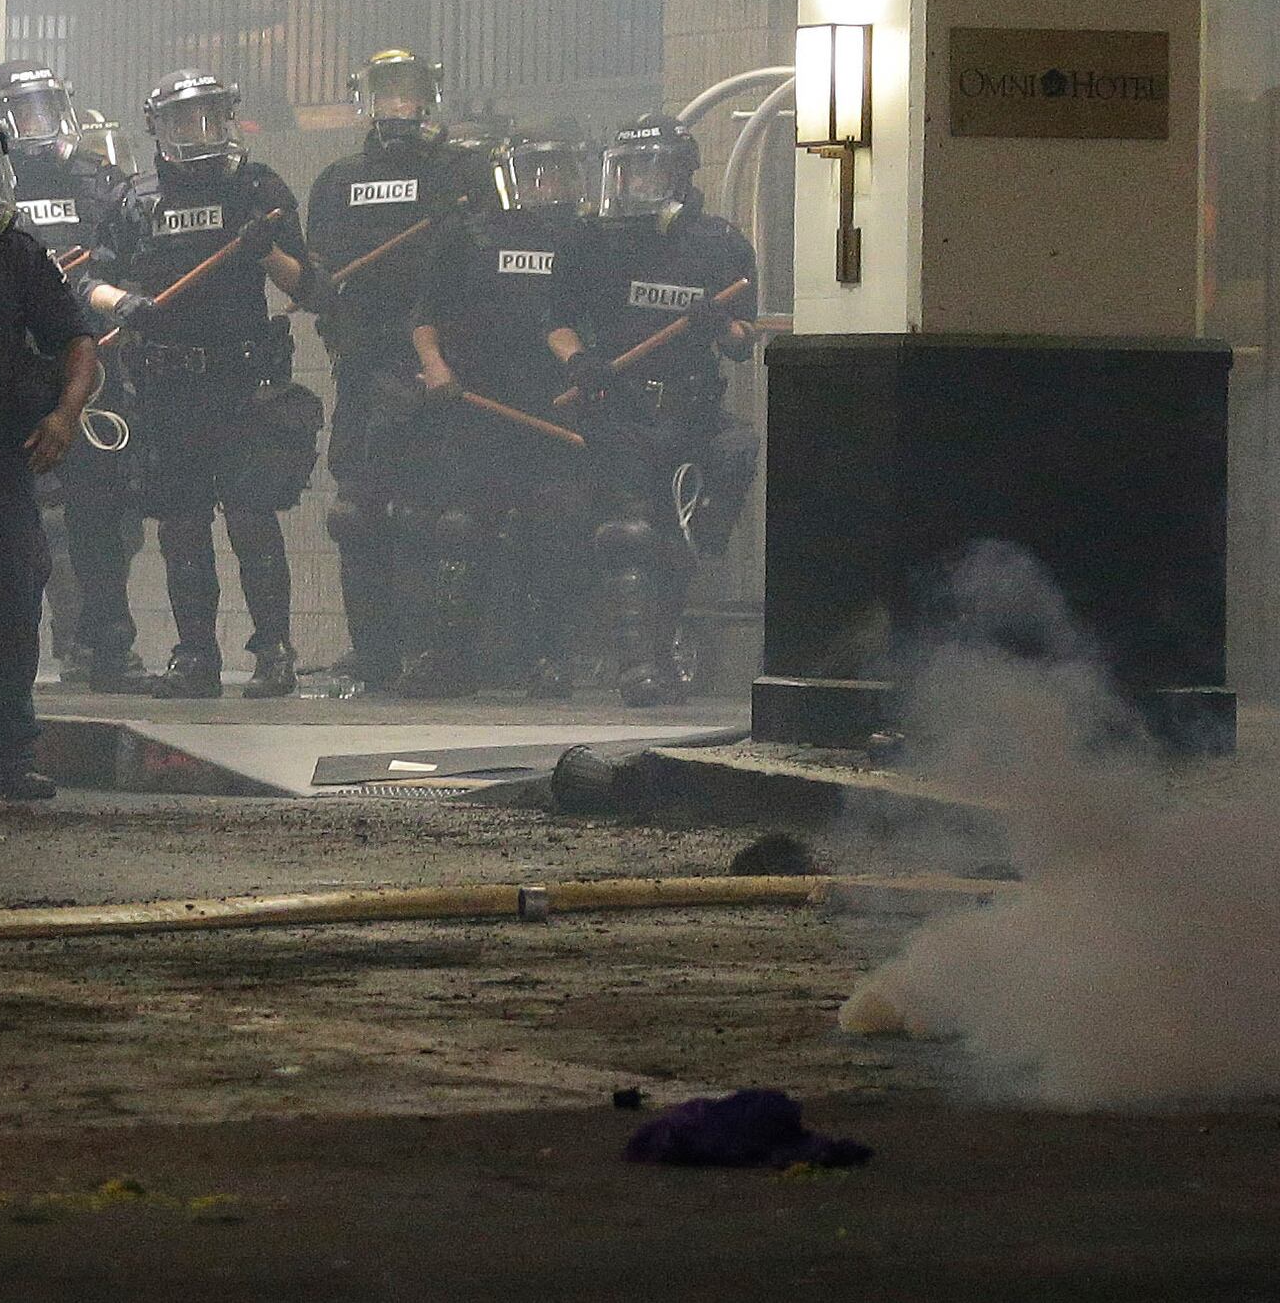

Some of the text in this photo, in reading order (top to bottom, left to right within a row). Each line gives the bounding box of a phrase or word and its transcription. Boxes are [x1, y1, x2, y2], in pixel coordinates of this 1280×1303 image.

[959, 68, 1160, 100] OMNI HOTEL
[353, 183, 414, 202] POLICE
[503, 254, 554, 271] POLIC
